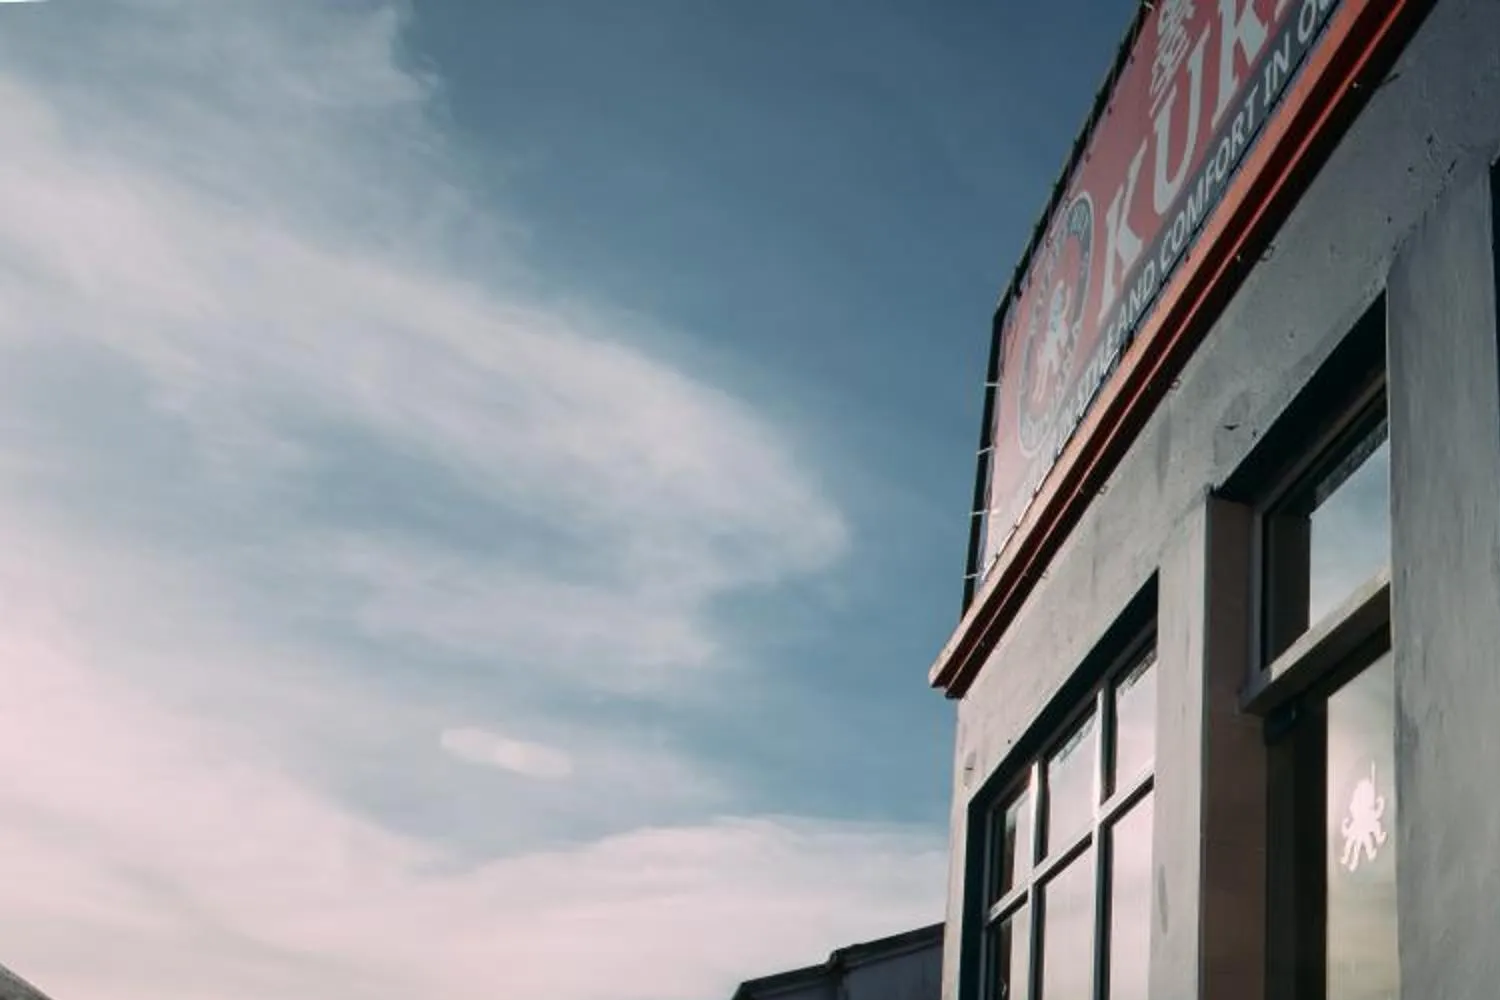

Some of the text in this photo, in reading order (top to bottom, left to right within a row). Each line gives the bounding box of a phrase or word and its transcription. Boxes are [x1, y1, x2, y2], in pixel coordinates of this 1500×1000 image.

[1116, 260, 1156, 345] AND
[1159, 83, 1259, 274] COMFORT
[1263, 30, 1291, 107] IN
